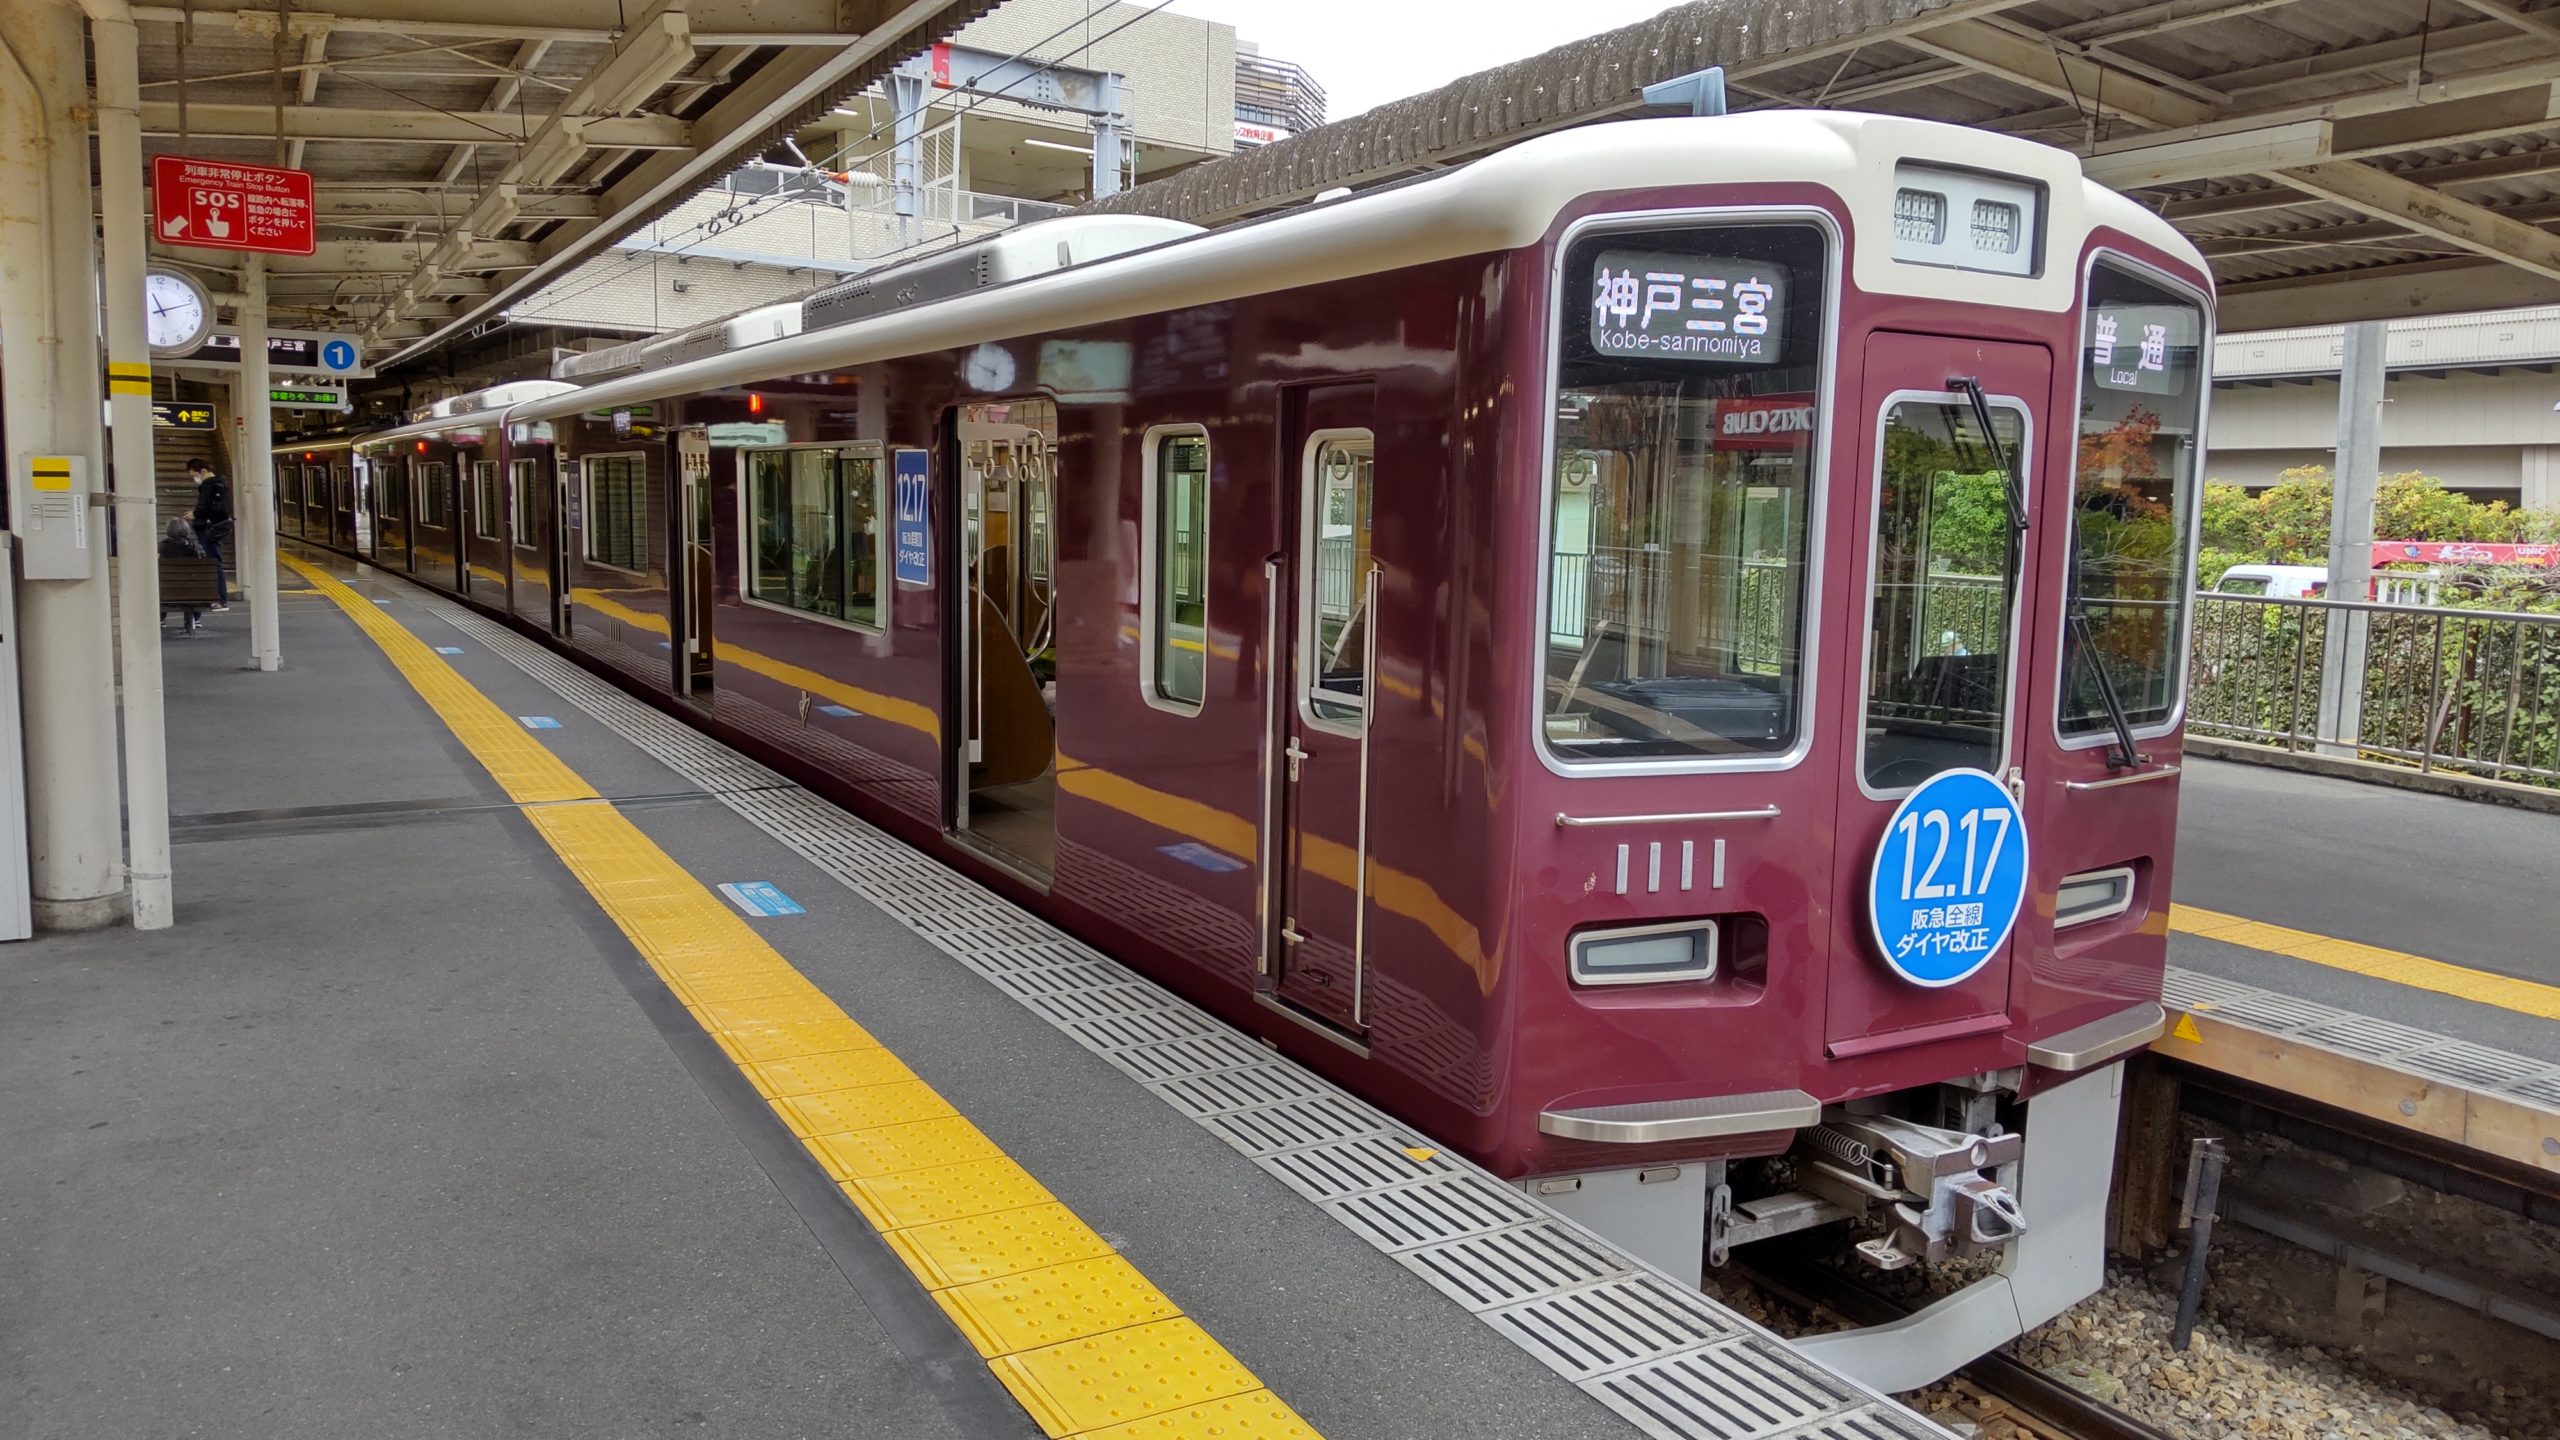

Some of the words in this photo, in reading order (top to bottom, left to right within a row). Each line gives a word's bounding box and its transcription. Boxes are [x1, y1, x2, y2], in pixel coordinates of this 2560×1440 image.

[184, 164, 286, 184] 列車非常停止ボタン
[178, 175, 224, 188] Emergency
[225, 180, 245, 188] Train
[245, 182, 264, 192] Stop
[265, 184, 291, 193] Button
[195, 190, 240, 209] SOS
[248, 204, 298, 217] 緊急の場合に
[248, 215, 306, 229] ボタンを押して
[249, 227, 283, 236] ください
[156, 277, 165, 285] 12
[187, 294, 194, 302] 2
[1594, 267, 1774, 335] 神戸三宮
[192, 309, 199, 317] 3
[188, 323, 195, 331] 4
[160, 336, 167, 344] 6
[176, 334, 183, 342] 5
[1600, 328, 1762, 359] Kobe-sannomiya
[2138, 323, 2166, 371] 通
[331, 346, 344, 365] 1
[2110, 367, 2138, 386] Local
[898, 473, 926, 522] 12.17
[2517, 546, 2547, 555] UNIC
[1898, 807, 2012, 900] 12.17
[1911, 903, 1983, 930] 阪急全線
[1896, 928, 1991, 959] ダイヤ改正
